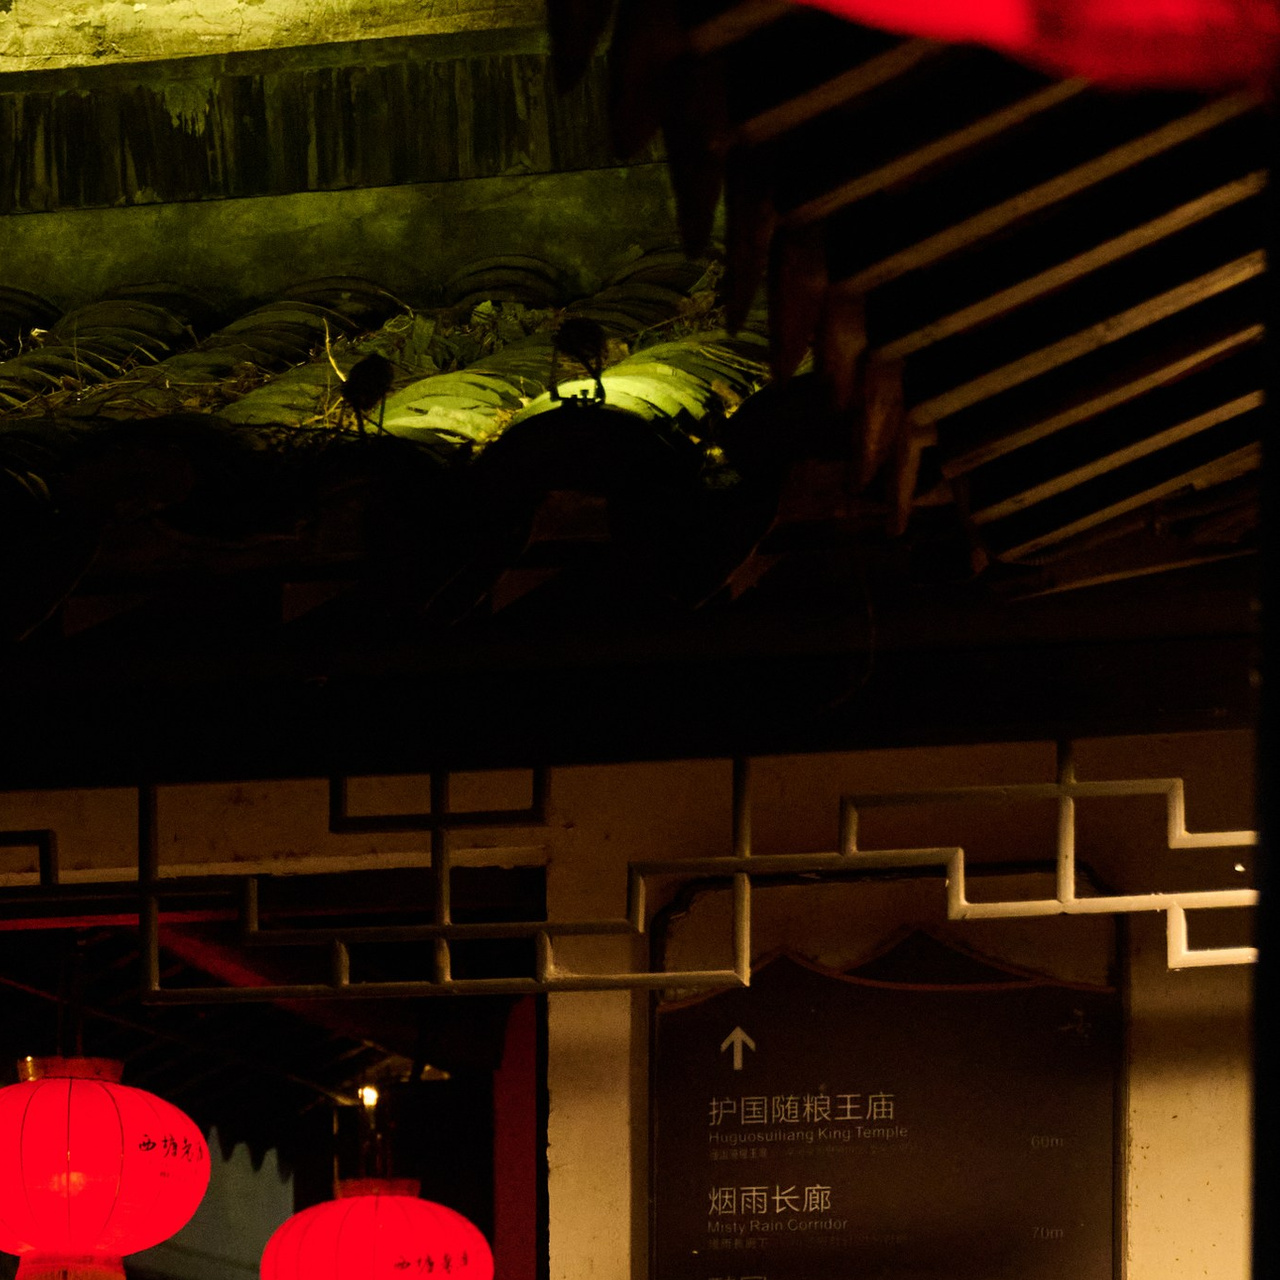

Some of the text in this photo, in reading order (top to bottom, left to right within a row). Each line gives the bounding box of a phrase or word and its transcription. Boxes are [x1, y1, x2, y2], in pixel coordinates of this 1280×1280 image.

[708, 1091, 895, 1127] 护国随粮王庙
[818, 1127, 851, 1143] King
[855, 1125, 909, 1142] Temple
[708, 1184, 832, 1216] 烟雨长廊
[707, 1218, 848, 1236] Misty Rain Corridor
